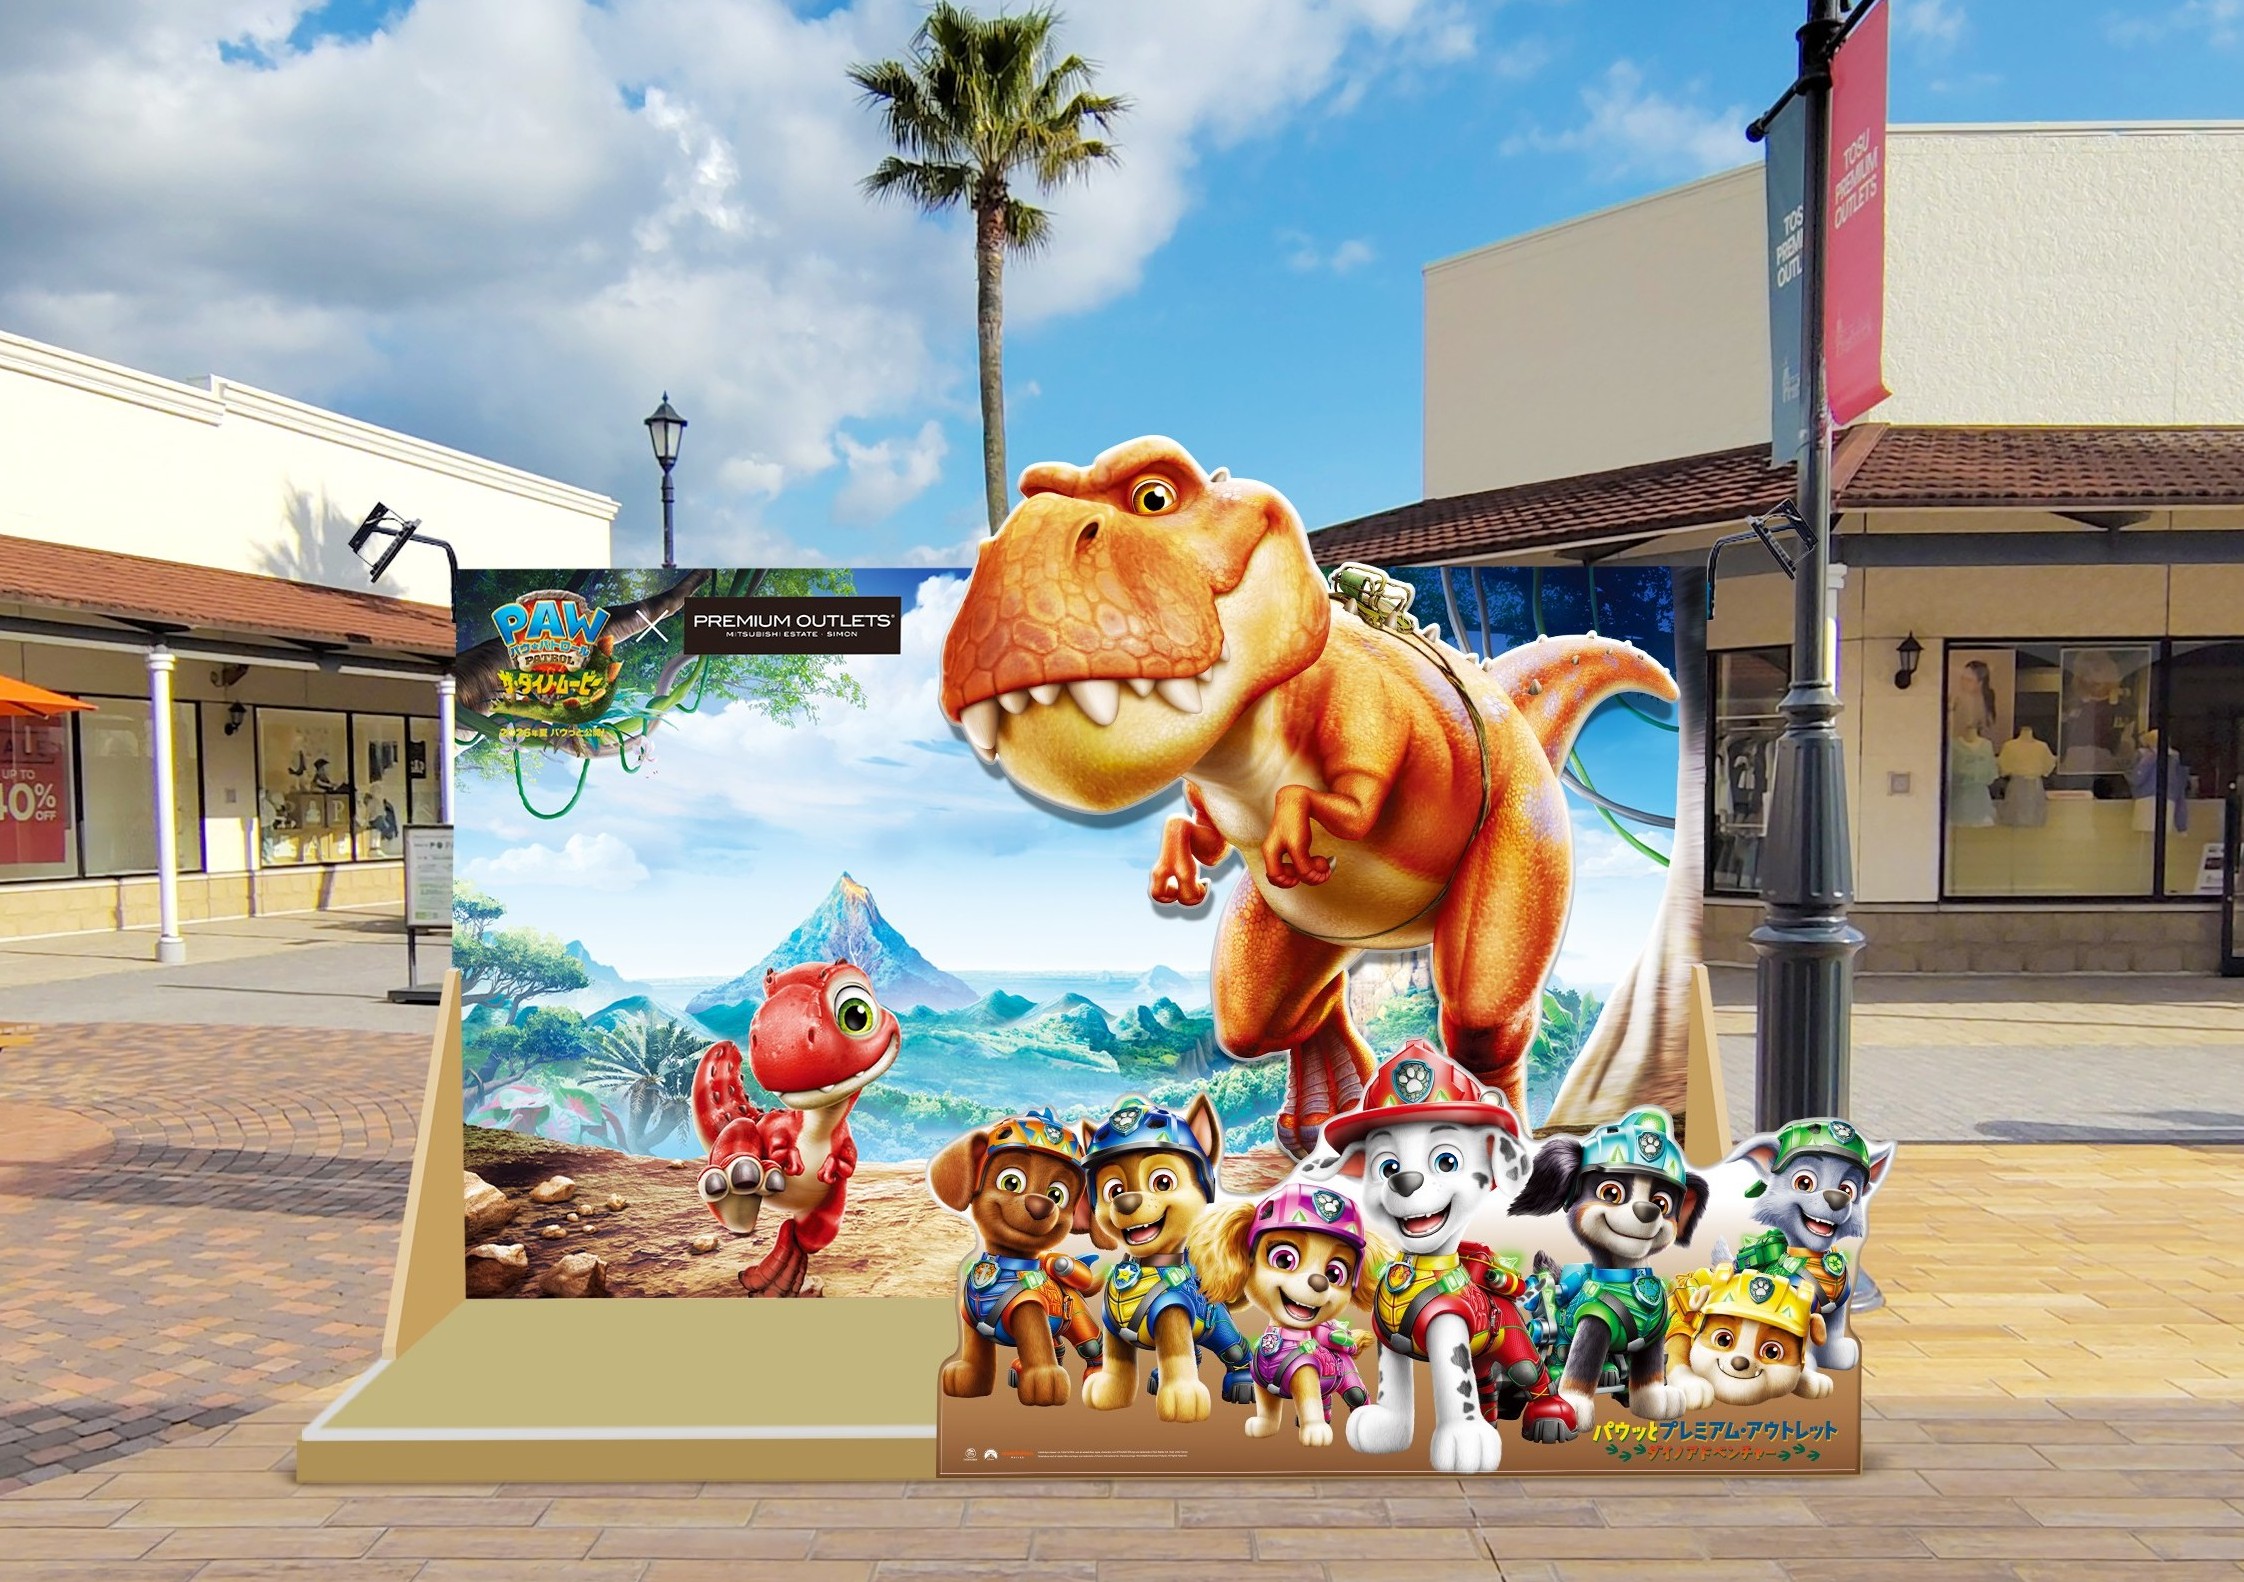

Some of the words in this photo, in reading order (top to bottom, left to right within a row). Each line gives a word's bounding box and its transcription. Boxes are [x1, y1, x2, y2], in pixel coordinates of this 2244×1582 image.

[1843, 127, 1870, 172] TOSU
[1835, 145, 1878, 206] PREMIUM
[1835, 173, 1877, 230] OUTLETS
[491, 600, 611, 647] PAW
[693, 614, 791, 628] PREMIUM
[525, 654, 575, 665] PATROL
[2, 769, 18, 780] UP
[20, 769, 36, 780] TO
[35, 810, 57, 821] OFF
